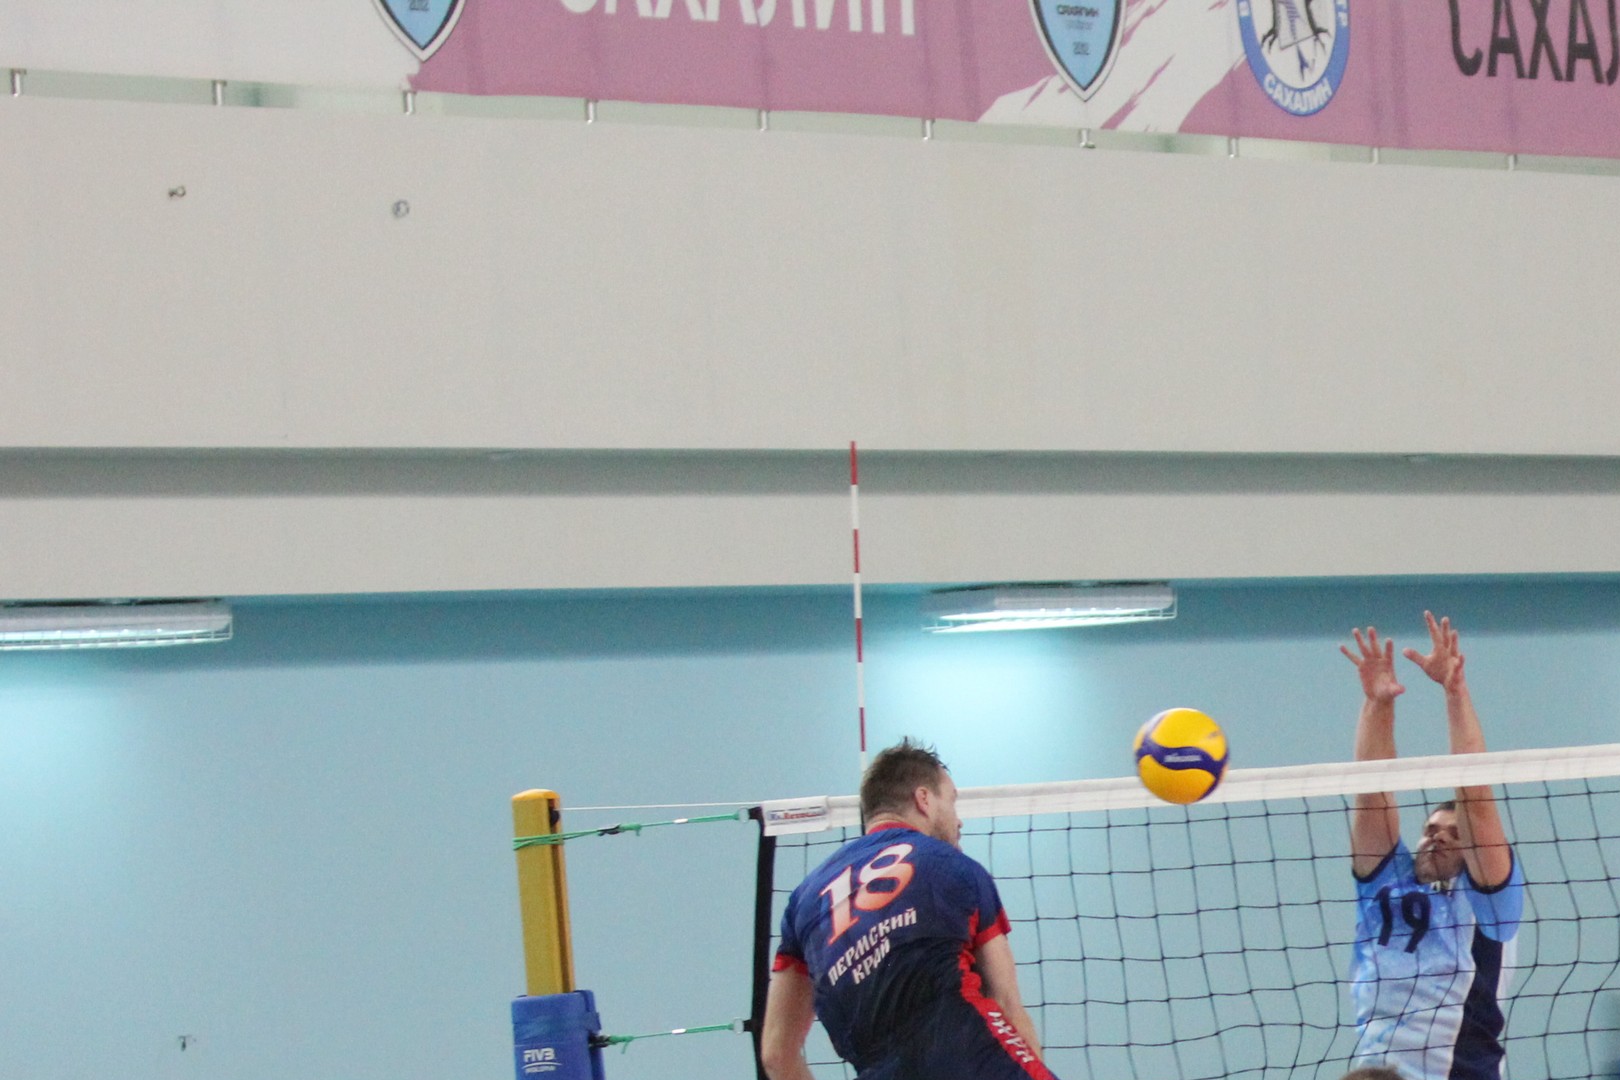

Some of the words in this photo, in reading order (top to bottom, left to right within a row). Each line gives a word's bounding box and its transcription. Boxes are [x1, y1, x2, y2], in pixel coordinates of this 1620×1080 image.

[819, 843, 915, 947] 18
[1372, 885, 1431, 954] 19
[828, 907, 918, 986] ПЕРМСКИЙ
[852, 938, 891, 985] КРАЙ
[523, 1047, 555, 1062] FIVB
